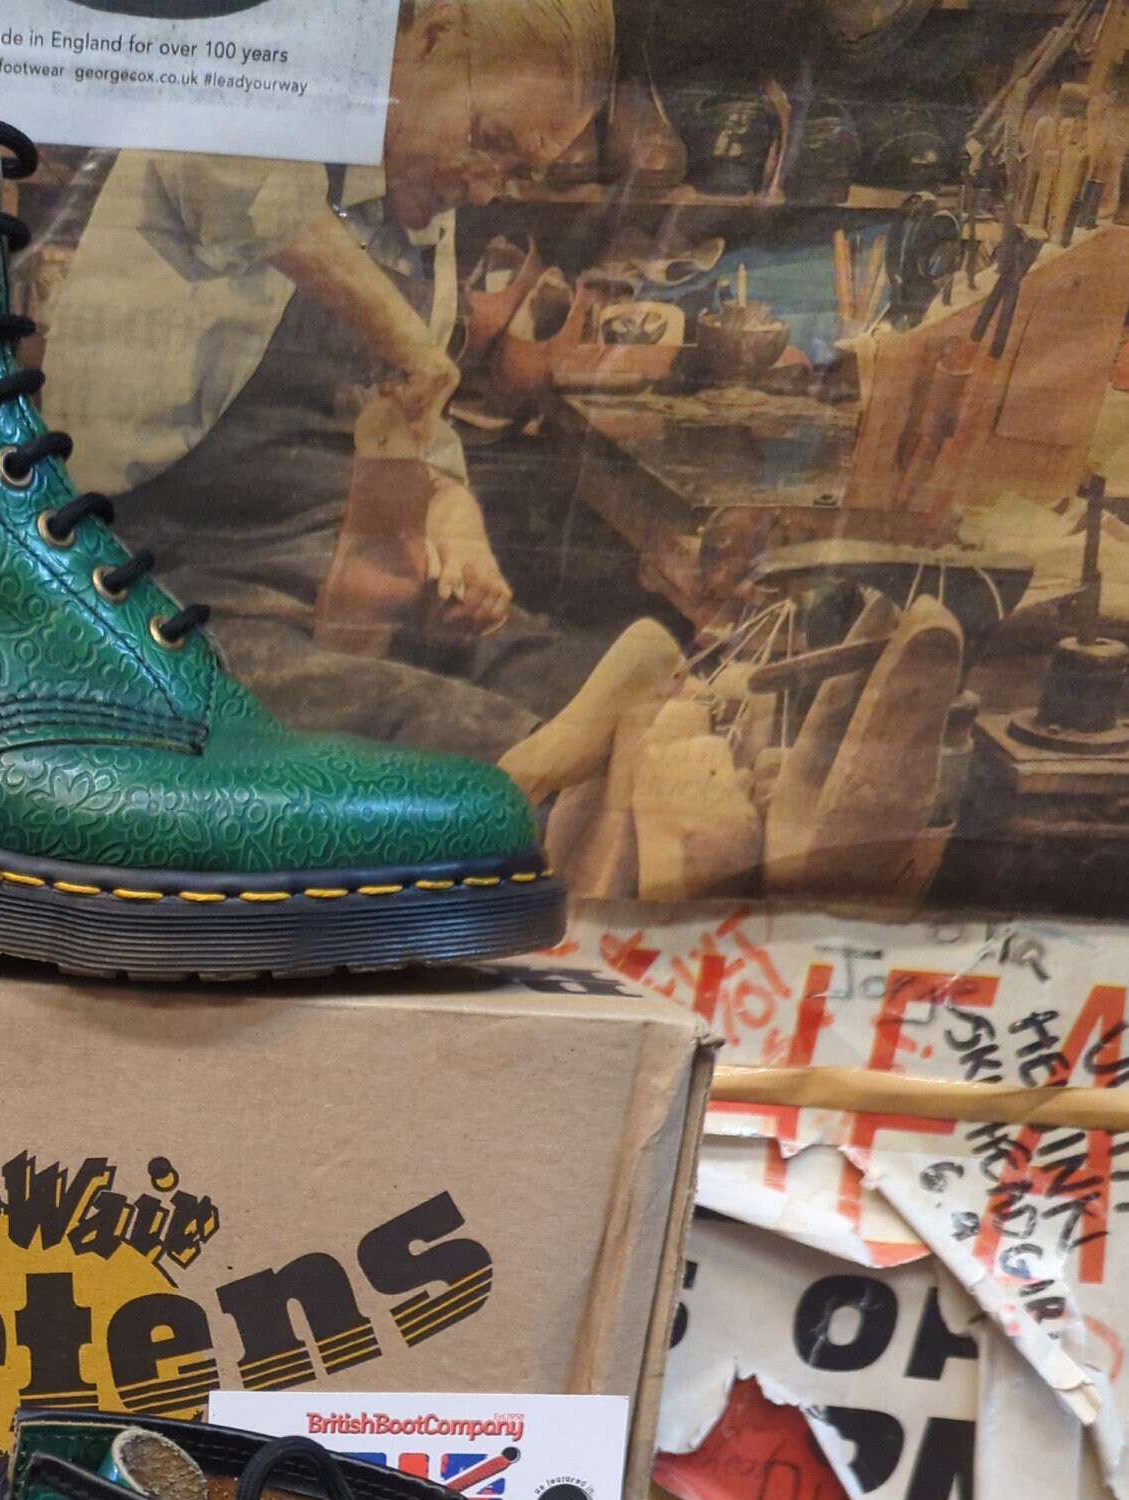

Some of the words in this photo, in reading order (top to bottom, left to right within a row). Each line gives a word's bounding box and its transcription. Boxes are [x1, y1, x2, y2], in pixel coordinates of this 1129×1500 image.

[29, 30, 44, 47] in
[51, 31, 122, 54] England
[129, 34, 154, 54] for
[159, 42, 198, 57] over
[206, 41, 236, 59] 100
[241, 47, 288, 65] years
[74, 66, 198, 85] georgecox.co.uk
[204, 72, 308, 97] #leadyourway
[306, 1411, 525, 1442] BritishBootCompany
